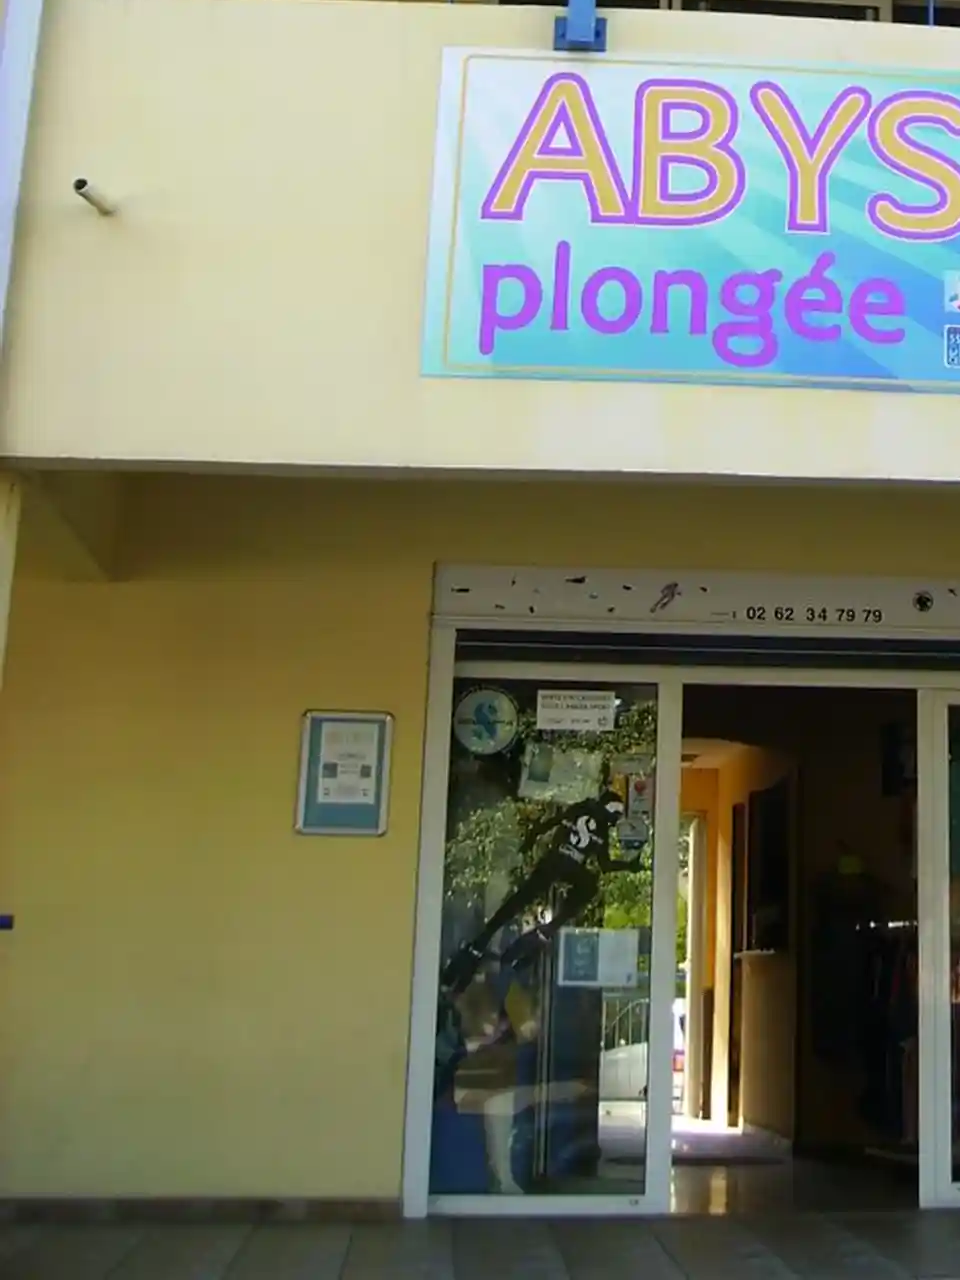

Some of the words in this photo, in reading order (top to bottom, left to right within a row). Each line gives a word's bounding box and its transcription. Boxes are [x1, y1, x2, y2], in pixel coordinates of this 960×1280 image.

[479, 240, 906, 368] plongée
[746, 606, 766, 621] 02
[774, 606, 794, 621] 62
[806, 607, 828, 622] 34
[835, 608, 856, 623] 79
[862, 609, 883, 623] 79
